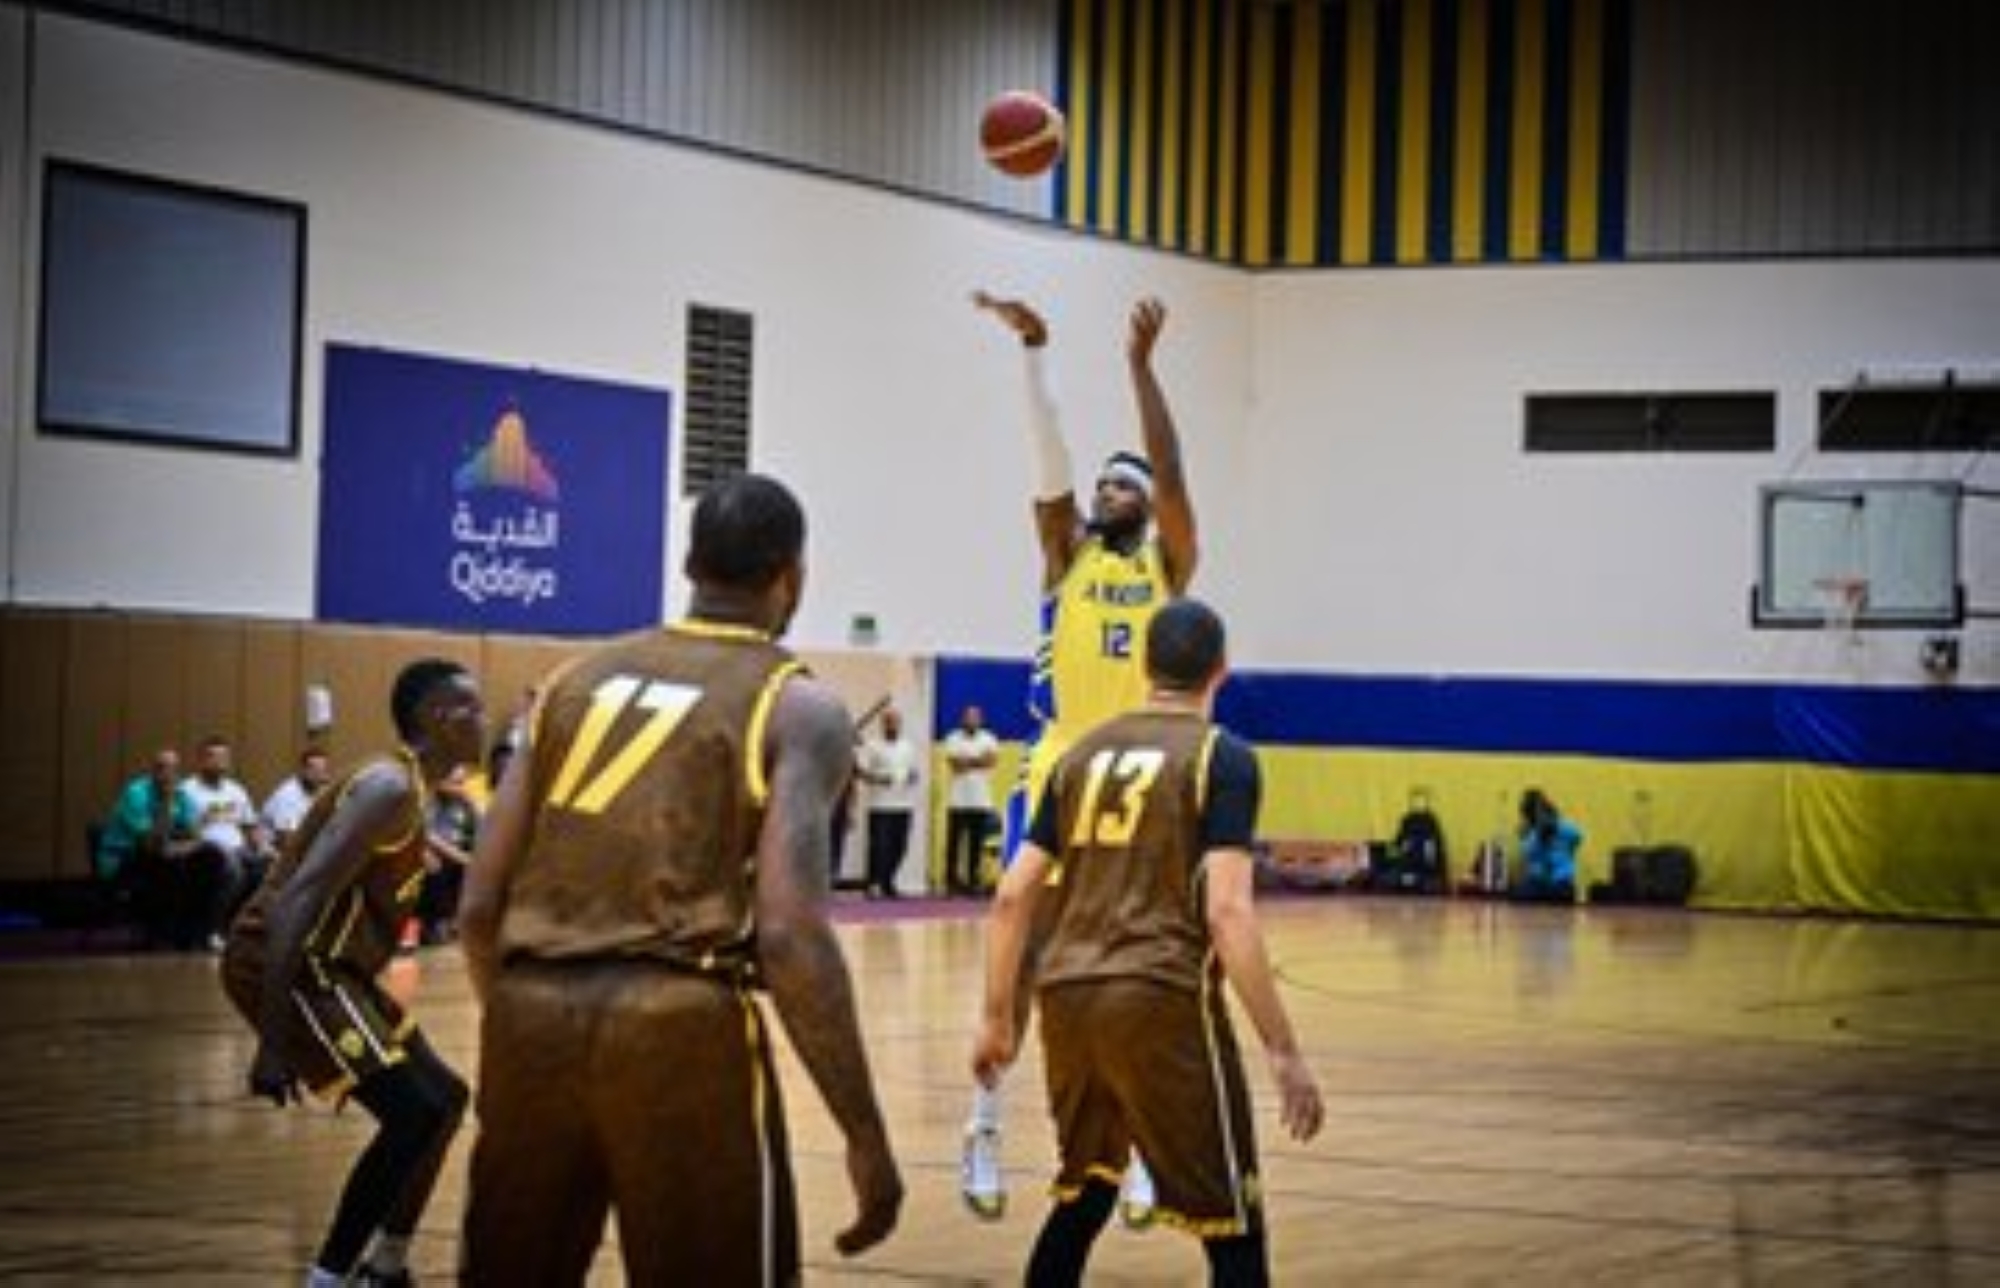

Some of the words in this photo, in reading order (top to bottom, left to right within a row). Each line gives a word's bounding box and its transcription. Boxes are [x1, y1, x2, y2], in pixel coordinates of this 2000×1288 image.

[451, 551, 557, 606] Qiddiya
[1102, 620, 1132, 659] 12
[547, 672, 703, 815] 17
[1069, 748, 1166, 845] 13
